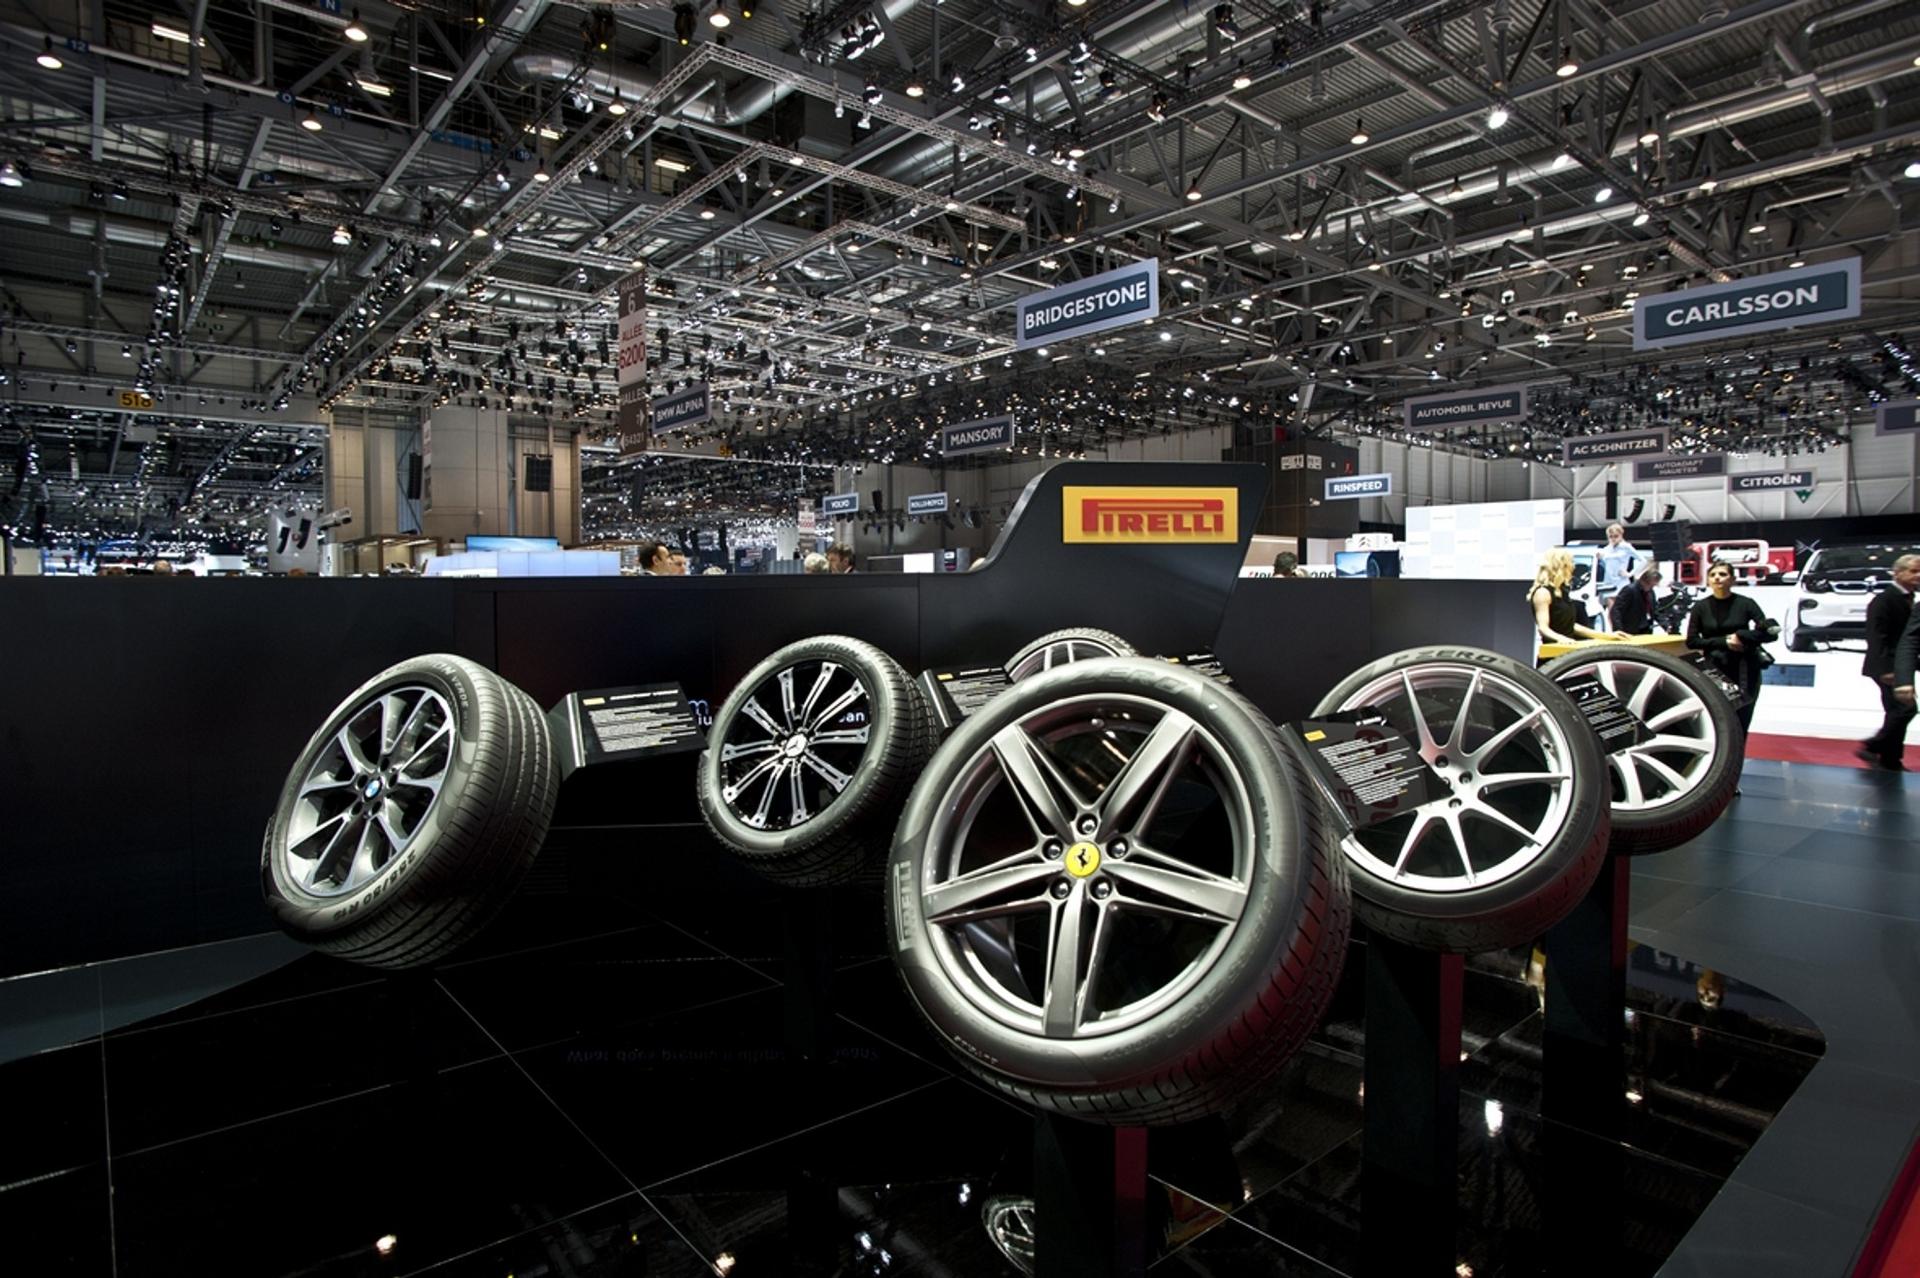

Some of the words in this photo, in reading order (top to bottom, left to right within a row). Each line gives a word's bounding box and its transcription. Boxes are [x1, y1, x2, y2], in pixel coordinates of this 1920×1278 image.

[628, 292, 636, 313] 6
[1025, 281, 1147, 329] BRIDGESTONE
[1665, 285, 1818, 327] CARLSSON
[121, 393, 152, 408] 518
[656, 405, 675, 422] BMW
[675, 397, 705, 416] ALPINA
[1416, 403, 1476, 419] AUTOMOBIL
[1478, 399, 1512, 411] REVUE
[950, 425, 1004, 446] MANSORY
[1573, 445, 1589, 455] AC
[1591, 438, 1658, 454] SCHNITZER
[1333, 479, 1383, 494] RINSPEED
[1081, 498, 1224, 534] PIRELLI
[1415, 649, 1498, 663] ZERO
